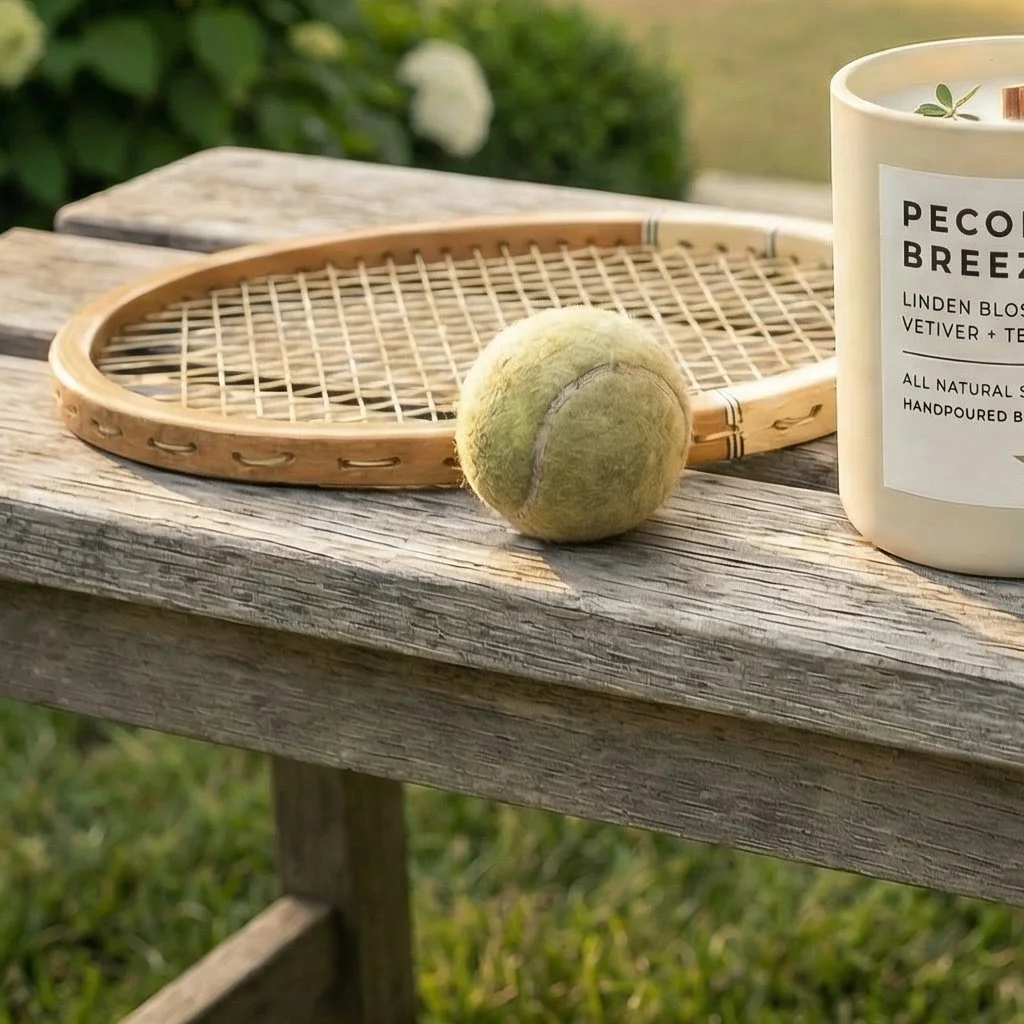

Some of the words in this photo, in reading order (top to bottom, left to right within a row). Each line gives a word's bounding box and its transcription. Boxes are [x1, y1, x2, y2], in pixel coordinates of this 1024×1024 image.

[903, 291, 970, 315] LINDEN
[902, 316, 979, 341] VETIVER
[903, 373, 930, 389] ALL
[937, 379, 1012, 398] NATURAL
[903, 398, 1007, 422] HANDPOURED
